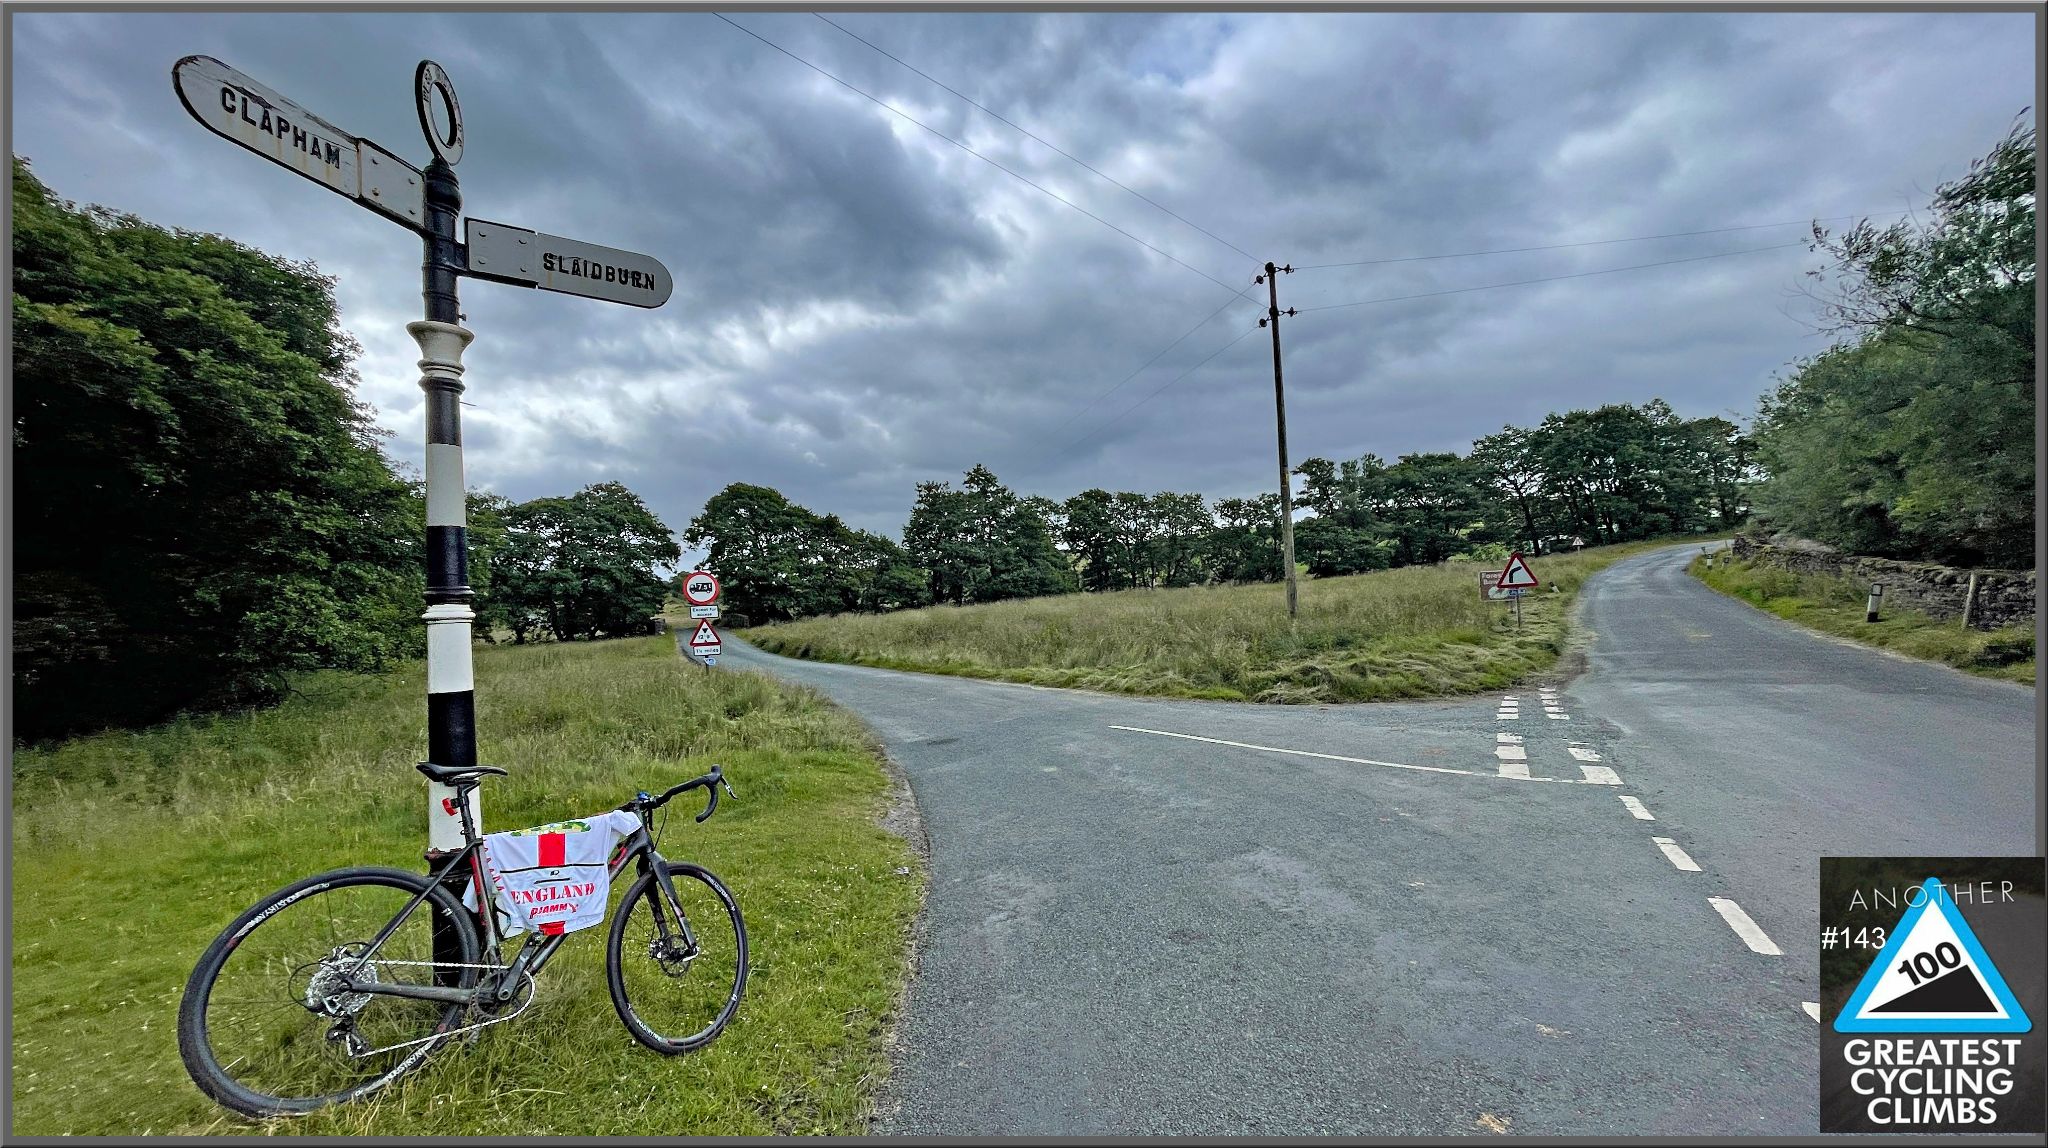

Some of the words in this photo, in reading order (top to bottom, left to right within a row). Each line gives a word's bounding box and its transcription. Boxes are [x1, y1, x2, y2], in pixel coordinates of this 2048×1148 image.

[221, 86, 340, 169] CLAPHAM
[543, 252, 655, 291] SLAIDBURN
[511, 882, 596, 905] ENGLAND
